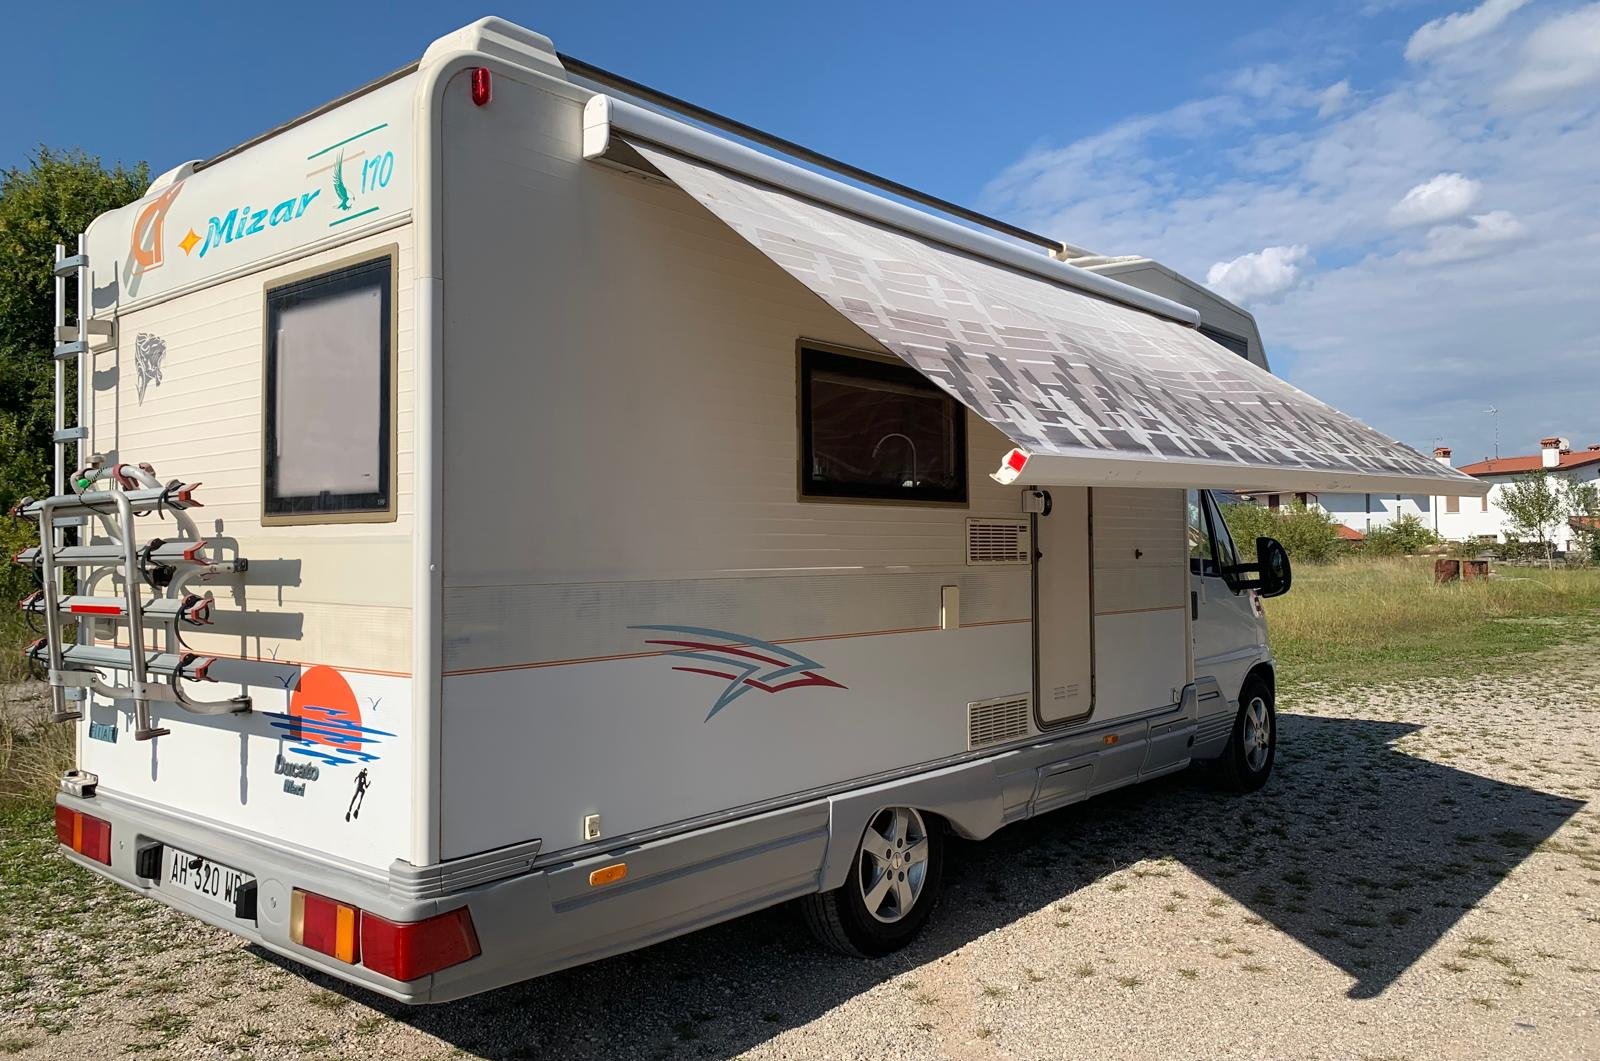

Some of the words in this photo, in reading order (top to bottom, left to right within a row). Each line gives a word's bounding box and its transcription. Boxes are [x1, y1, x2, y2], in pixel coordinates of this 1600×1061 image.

[199, 188, 321, 258] Mizar
[275, 754, 320, 781] Ducato
[171, 853, 189, 885] AH
[195, 863, 220, 896] 320
